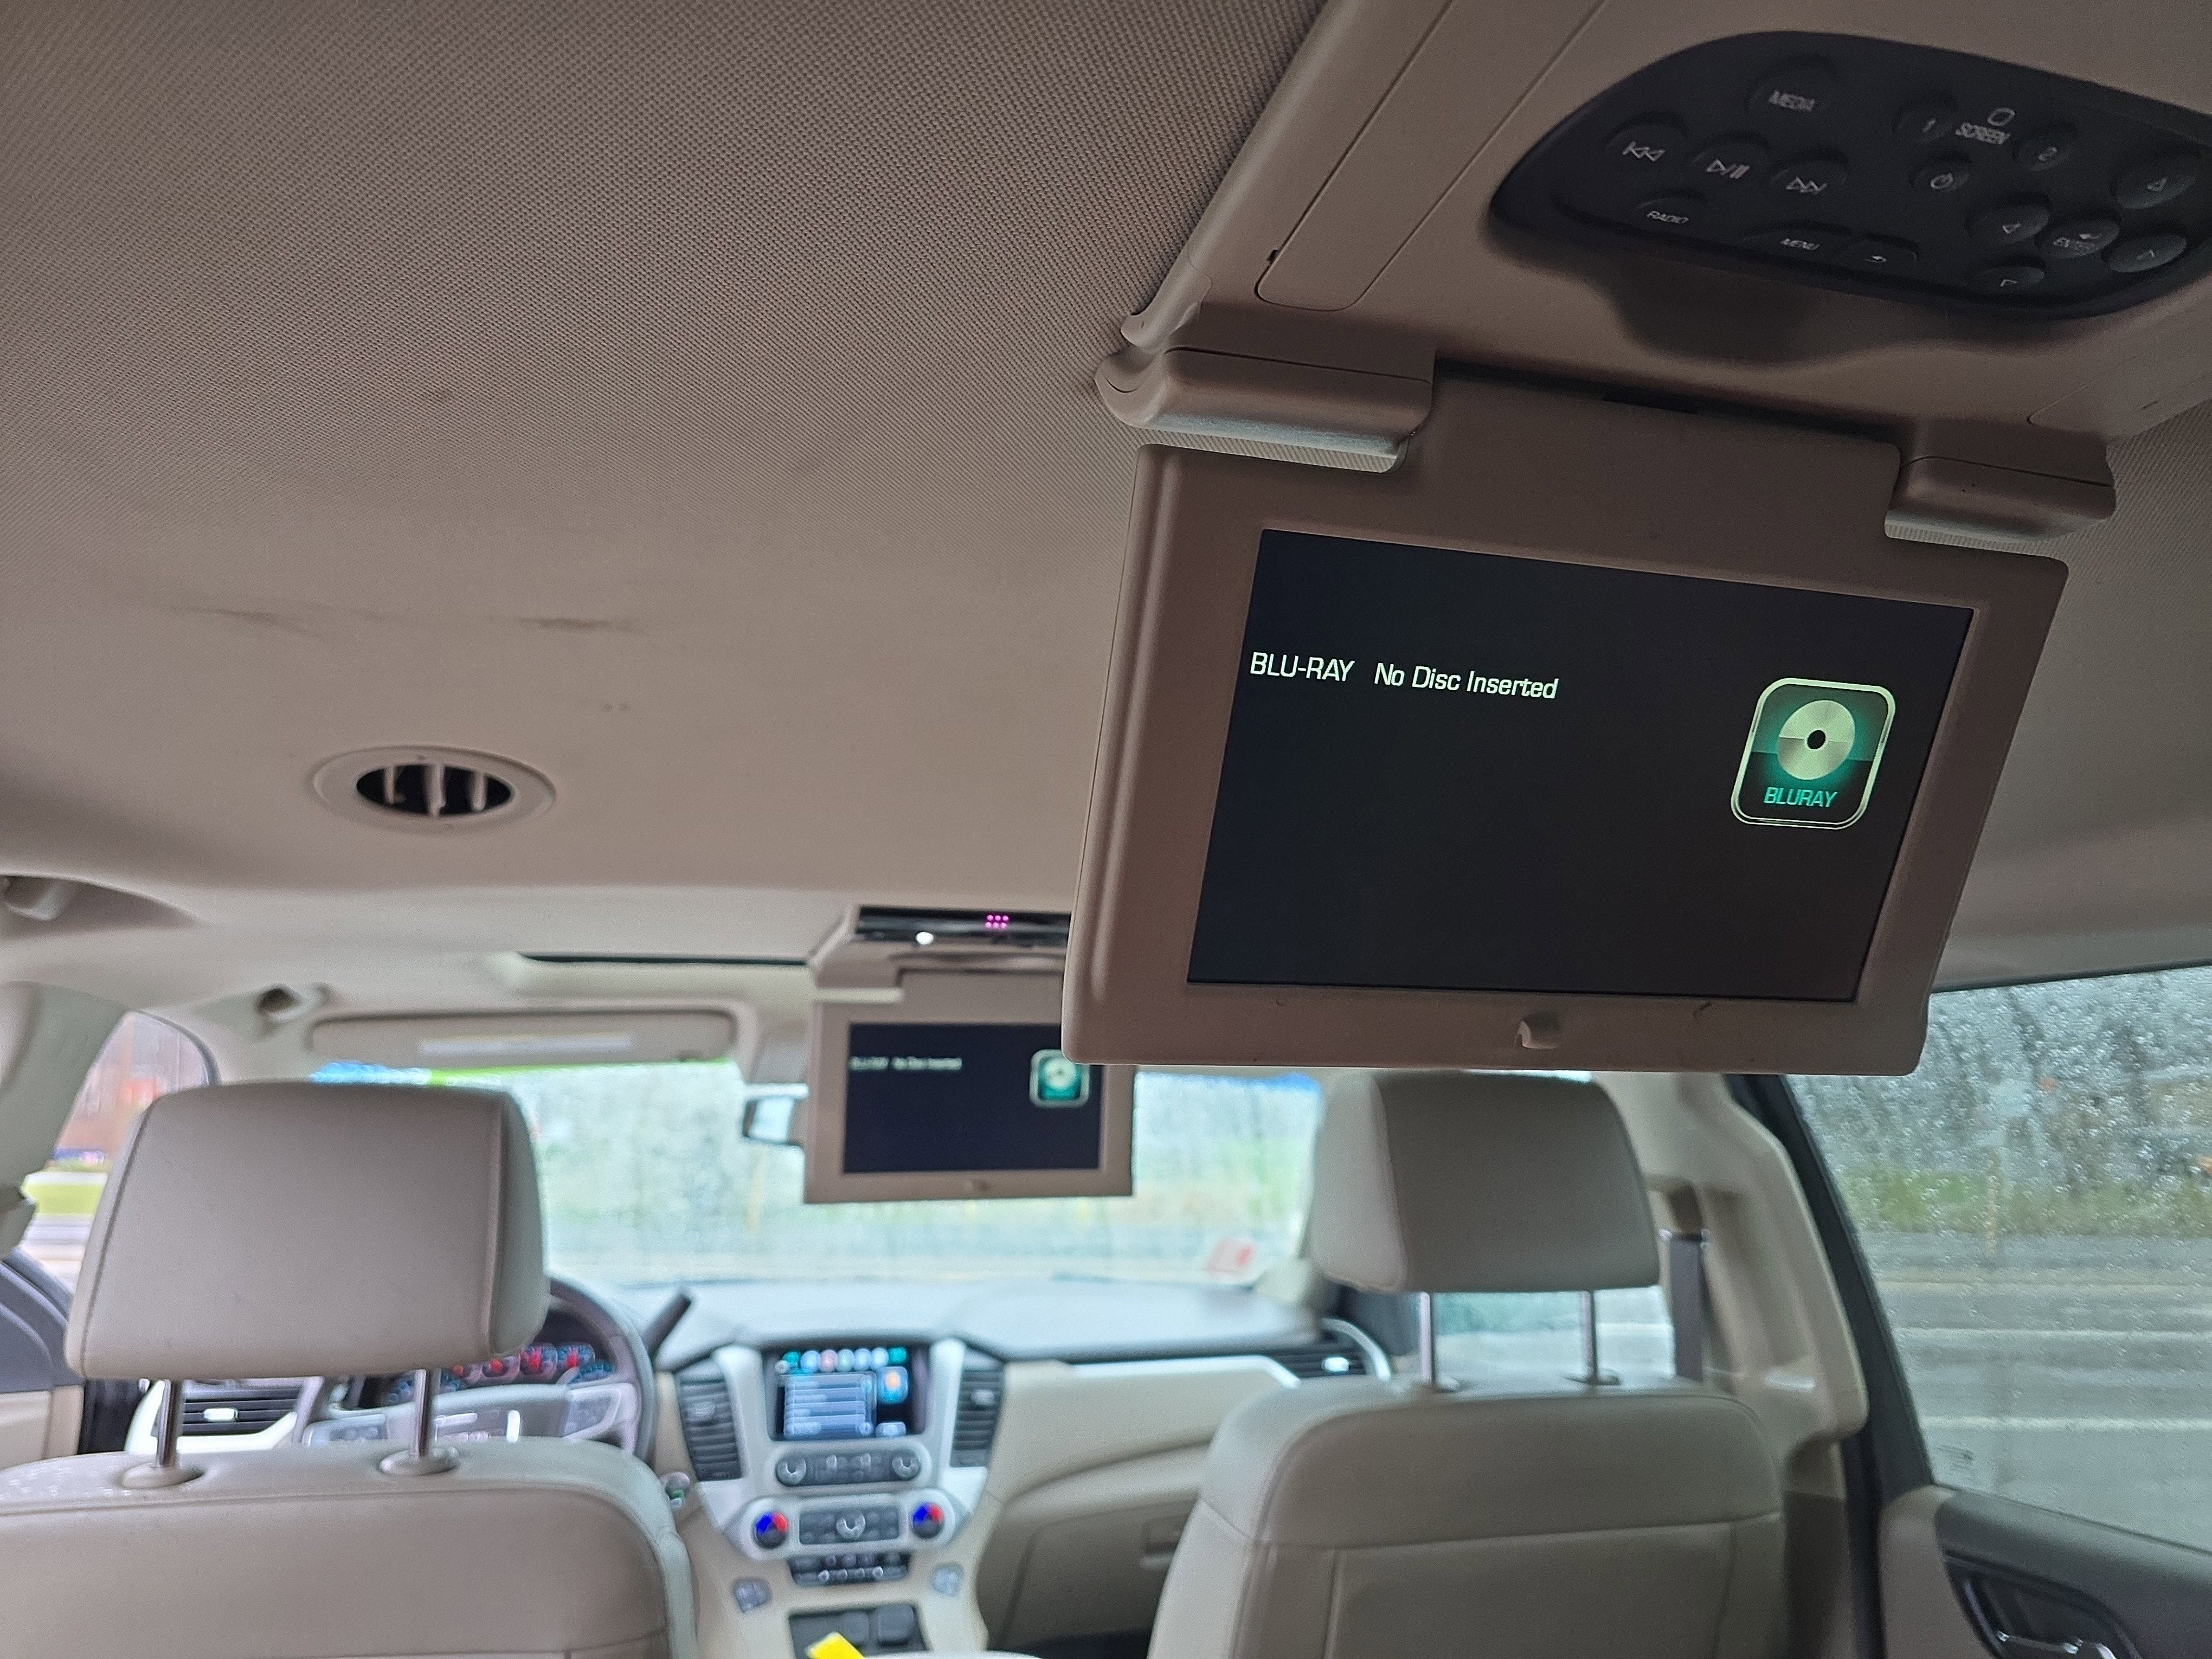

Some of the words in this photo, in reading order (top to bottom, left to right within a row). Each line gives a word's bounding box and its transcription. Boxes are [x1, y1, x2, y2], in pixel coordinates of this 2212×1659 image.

[1768, 90, 1815, 111] MEDIA
[1956, 123, 2011, 145] SCREEN
[1646, 210, 1689, 224] RADIO
[1780, 239, 1820, 251] MENU
[1250, 651, 1355, 682] BLU-RAY
[1373, 663, 1405, 686] No
[1411, 665, 1461, 691] Disc
[1466, 670, 1559, 699] Inserted
[1763, 787, 1838, 808] BLURAY
